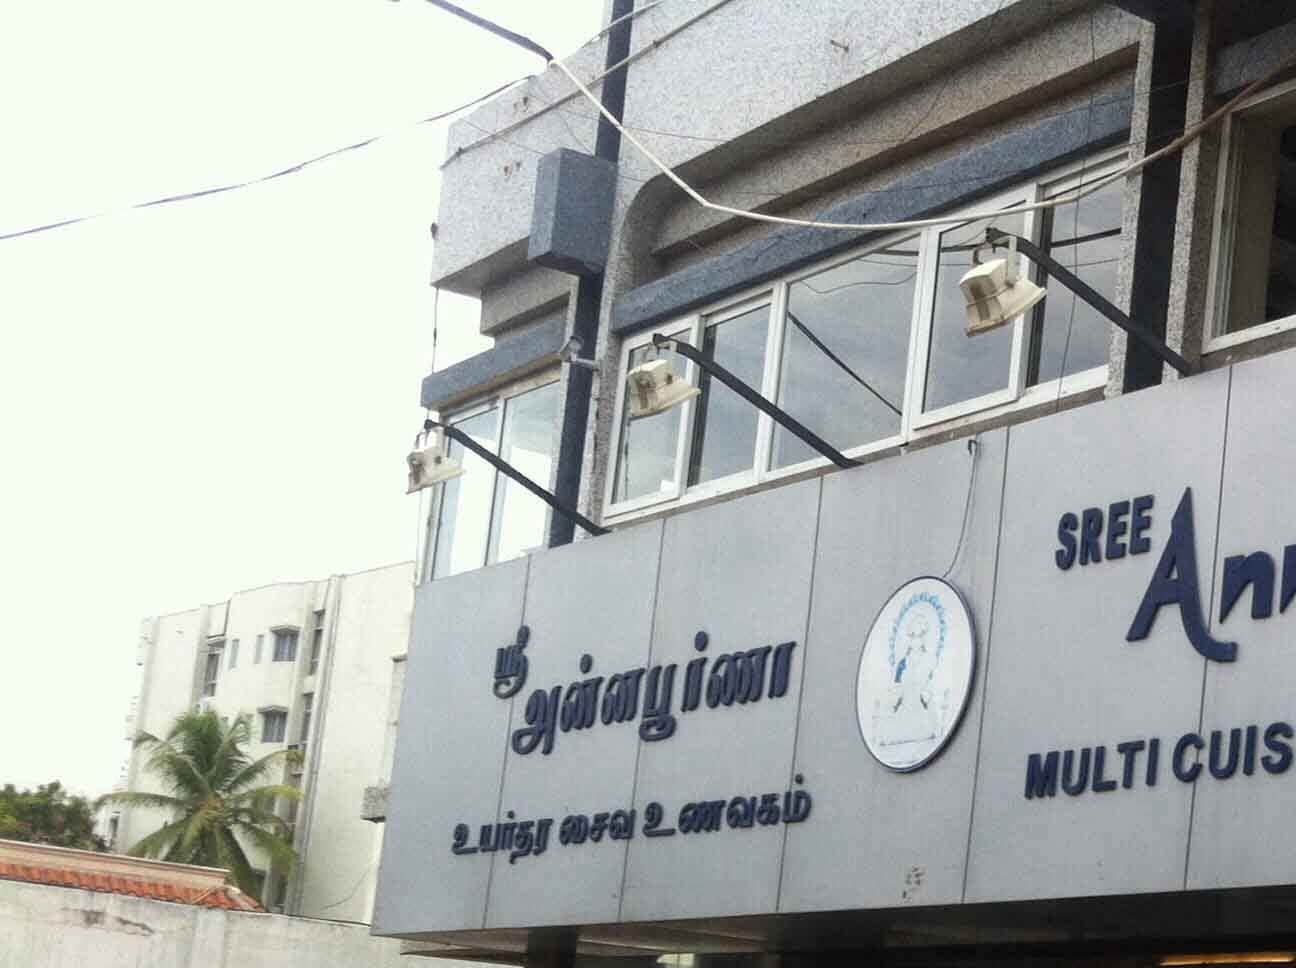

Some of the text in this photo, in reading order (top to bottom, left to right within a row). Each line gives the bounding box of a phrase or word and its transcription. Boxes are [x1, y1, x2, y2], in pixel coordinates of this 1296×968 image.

[1057, 495, 1154, 570] SREE
[512, 632, 796, 754] அன்னபூர்ணா
[1024, 738, 1160, 800] MULTI
[452, 775, 813, 864] உயர்தர சைவ உணவகம்
